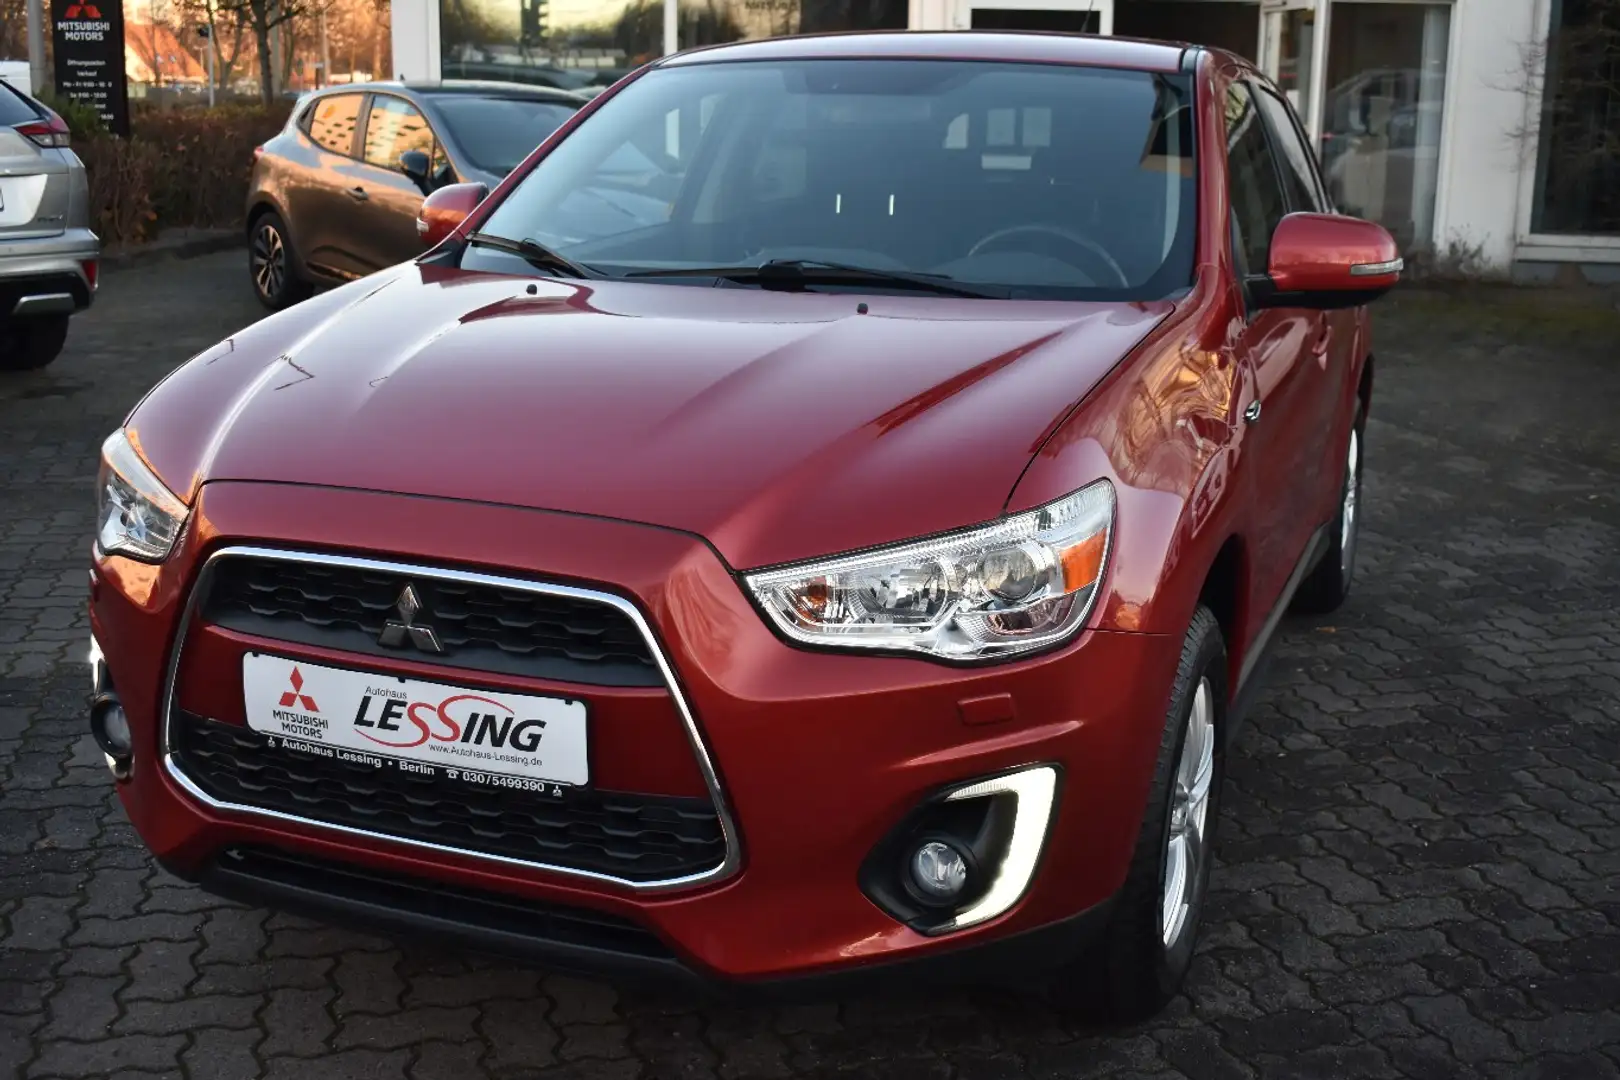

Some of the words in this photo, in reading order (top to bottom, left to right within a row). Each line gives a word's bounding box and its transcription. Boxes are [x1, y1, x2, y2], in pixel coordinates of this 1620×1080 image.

[57, 21, 110, 31] MITSUBISHI
[65, 31, 104, 41] MOTORS
[365, 686, 408, 700] Autohaus
[272, 709, 329, 729] MITSUBISHI
[353, 694, 547, 753] LESSING
[281, 722, 323, 739] MOTORS
[428, 743, 543, 767] www.Autohaus-Lessing.de
[281, 738, 333, 758] Autohaus
[336, 749, 383, 768] Lessing
[399, 760, 435, 775] Berlin
[462, 771, 545, 792] 030/5499390
